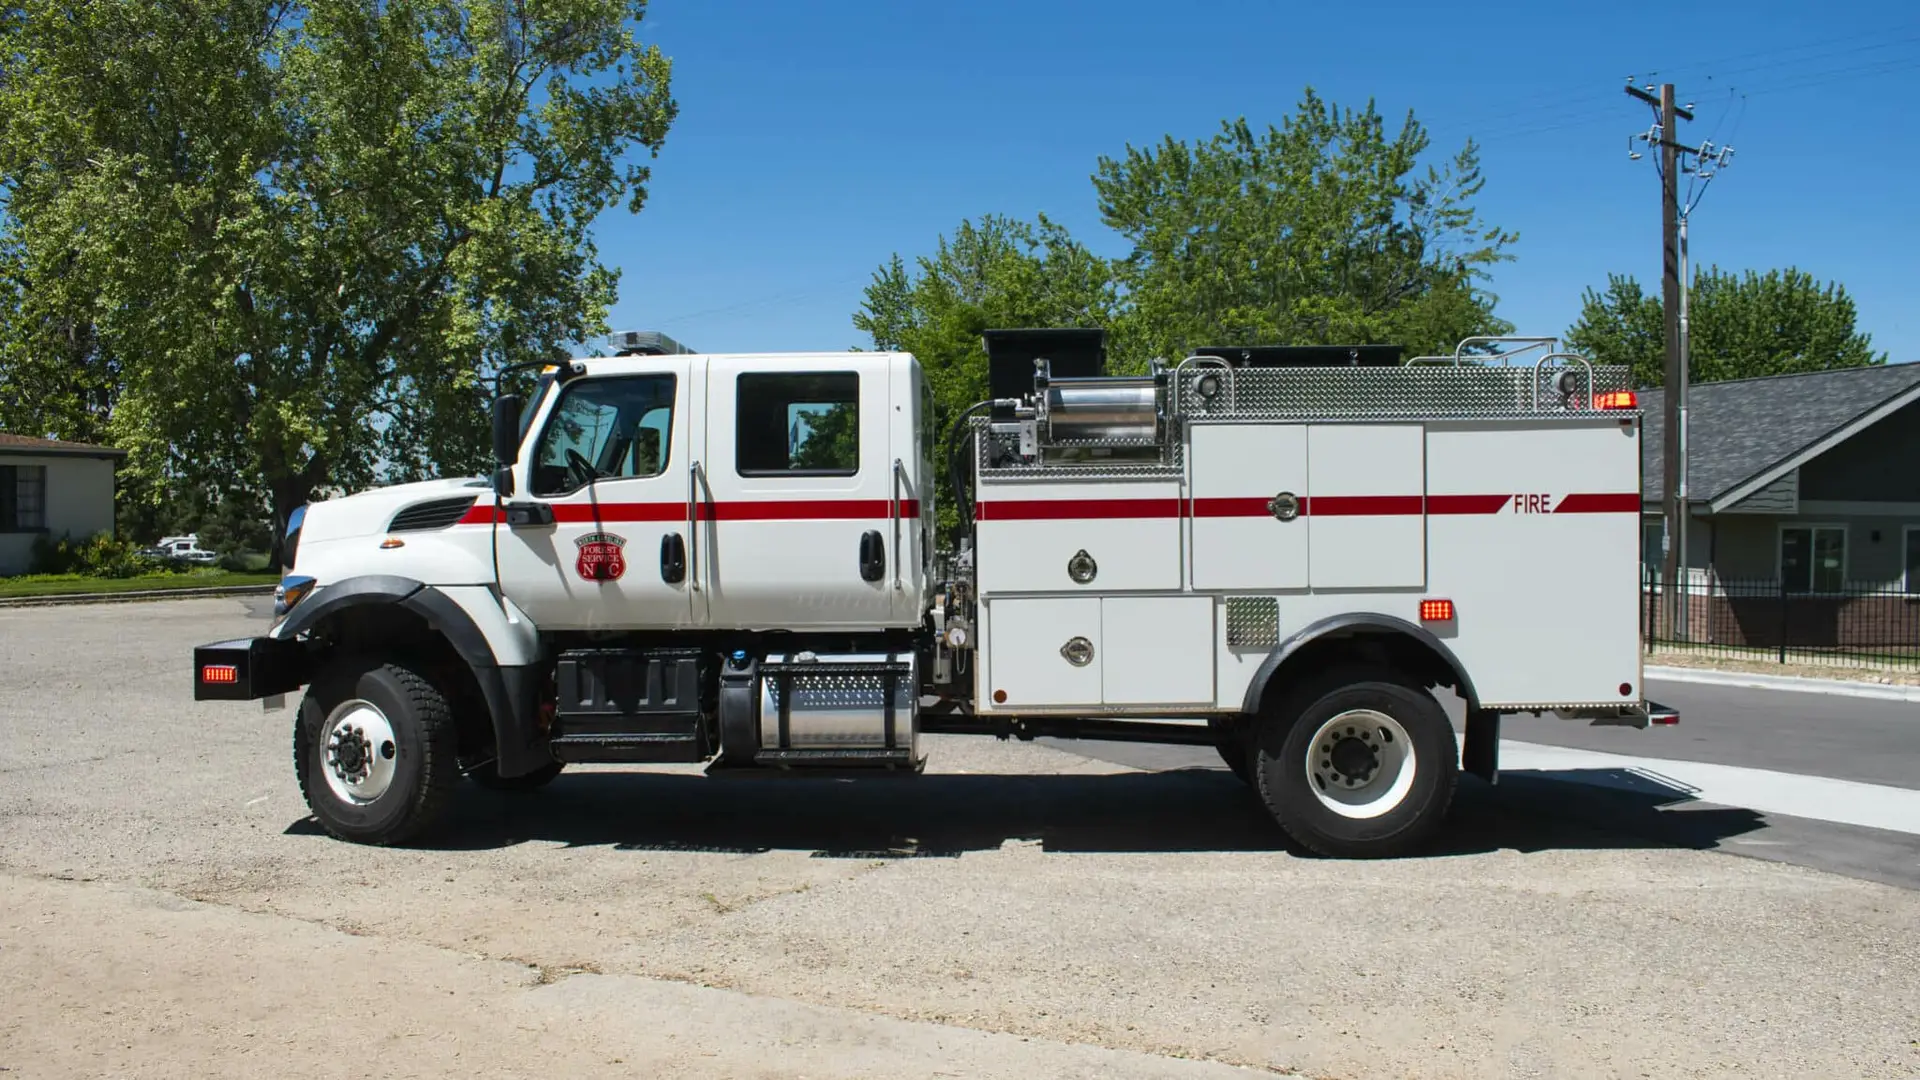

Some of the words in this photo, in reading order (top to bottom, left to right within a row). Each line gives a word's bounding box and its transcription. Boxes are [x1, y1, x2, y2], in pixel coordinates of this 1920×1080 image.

[1514, 493, 1551, 514] FIRE
[583, 546, 617, 554] FOREST
[582, 554, 619, 562] SERVICE
[583, 563, 594, 576] N
[609, 563, 620, 576] C
